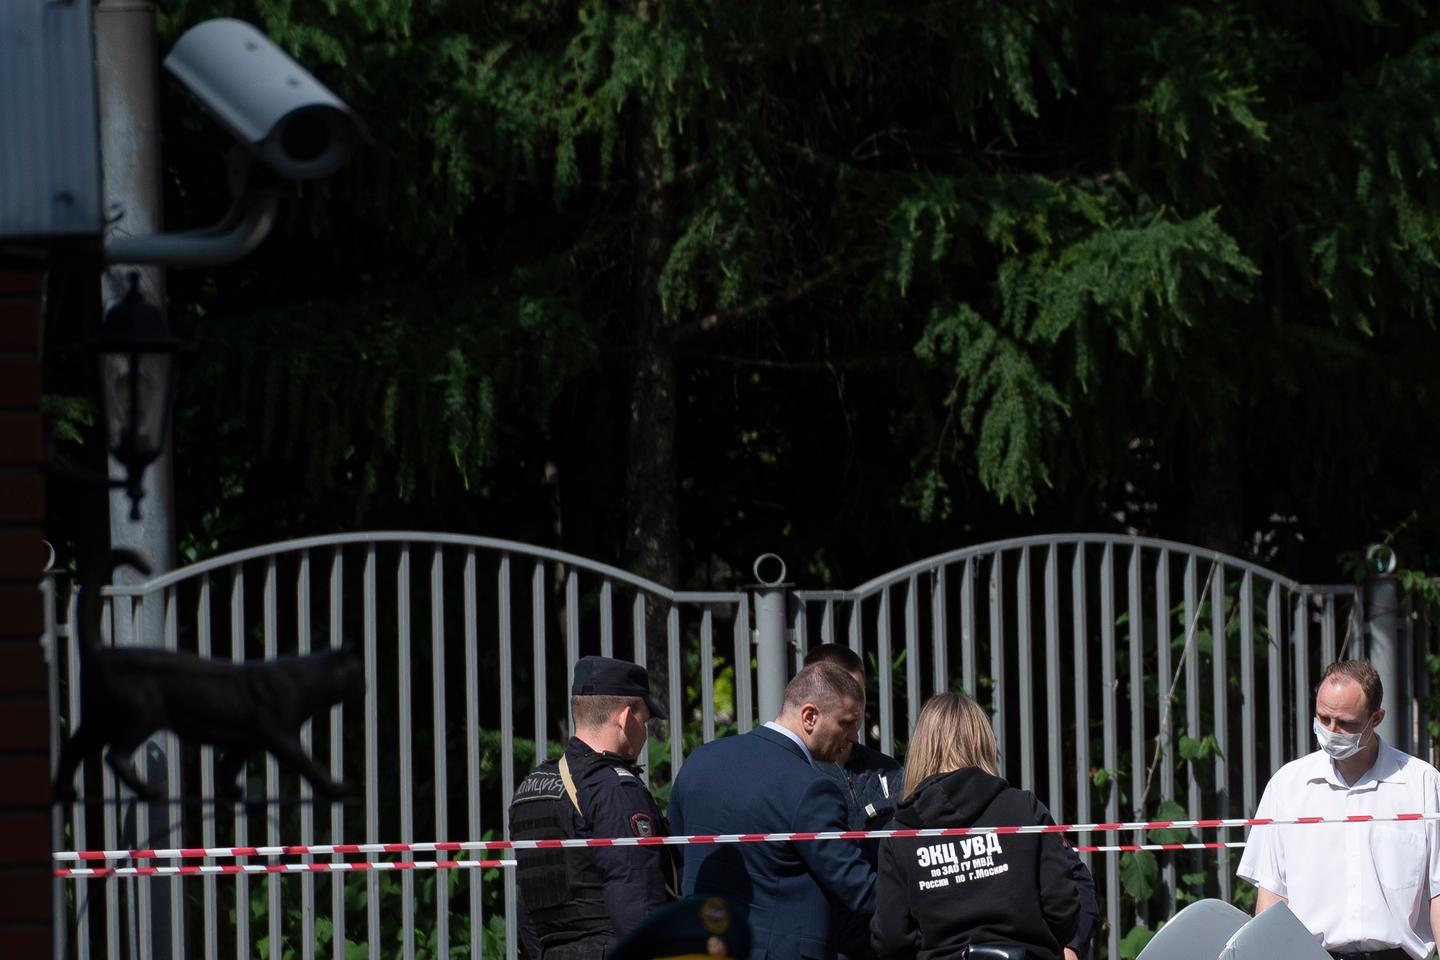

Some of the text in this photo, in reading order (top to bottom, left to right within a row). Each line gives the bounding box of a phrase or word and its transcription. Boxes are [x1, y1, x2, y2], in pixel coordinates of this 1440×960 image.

[516, 777, 563, 795] ЛИЦИЯ
[916, 833, 1003, 868] ЭКЦ УВД
[931, 856, 995, 878] по ЗАО ГУ МВД
[919, 878, 949, 891] России
[955, 874, 966, 884] по
